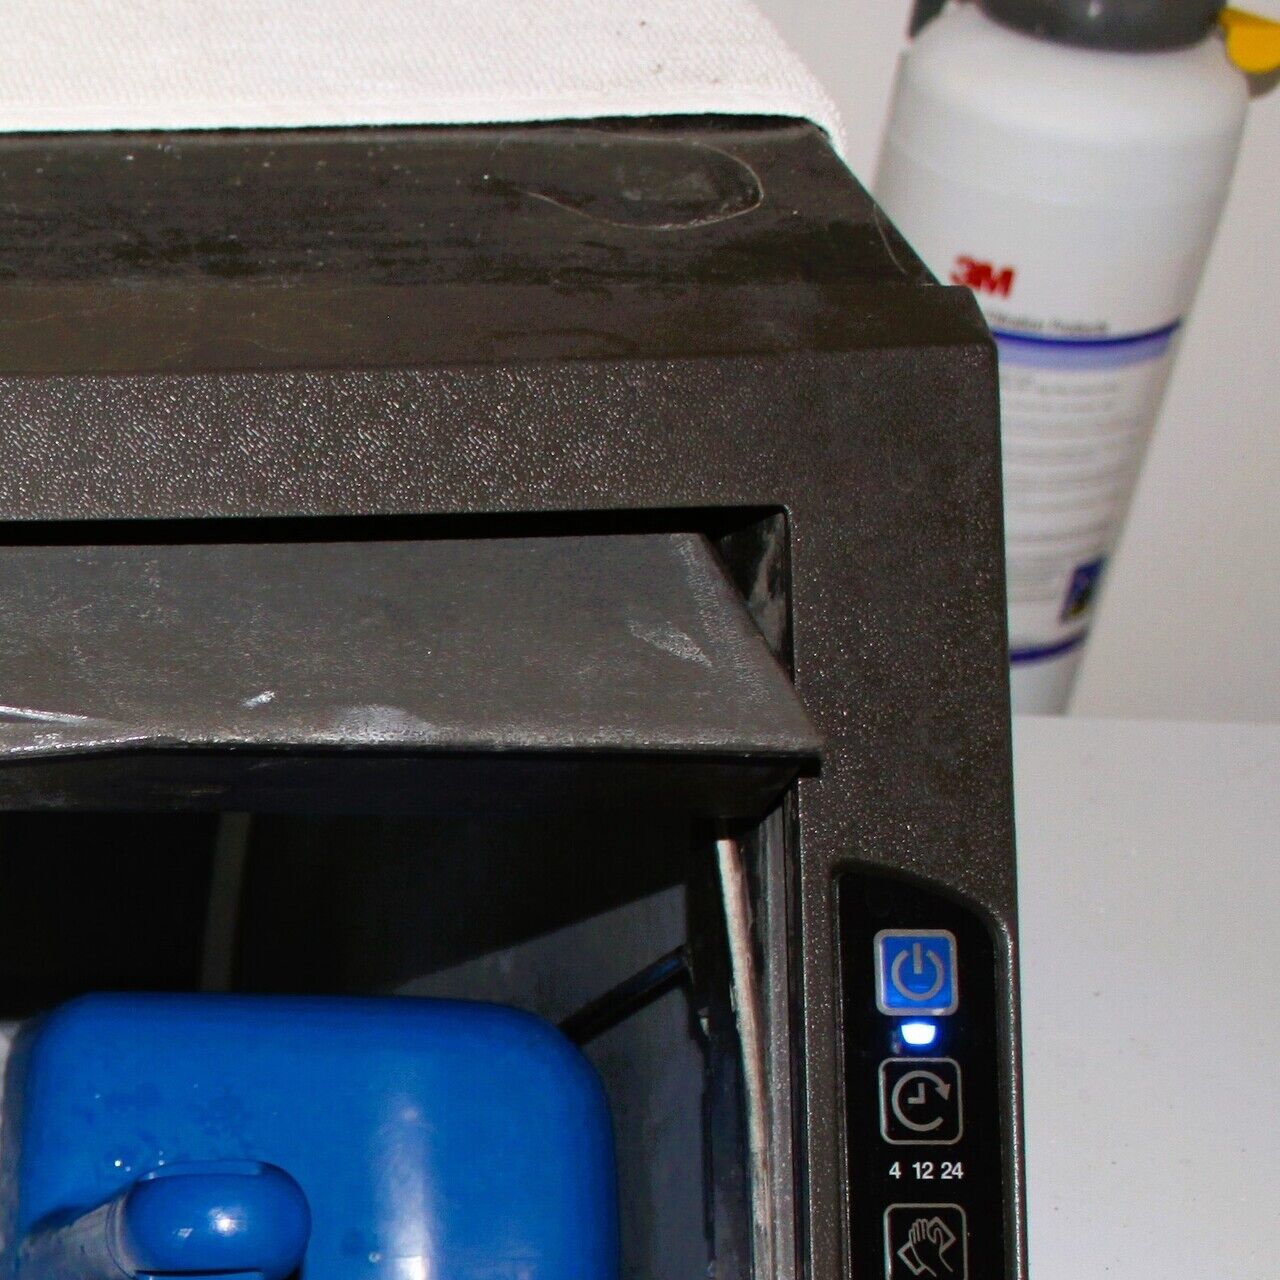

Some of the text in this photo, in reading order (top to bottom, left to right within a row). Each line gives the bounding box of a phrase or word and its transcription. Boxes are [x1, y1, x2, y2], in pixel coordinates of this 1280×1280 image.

[950, 256, 1014, 298] 3M
[888, 1161, 964, 1179] 4 12 24
